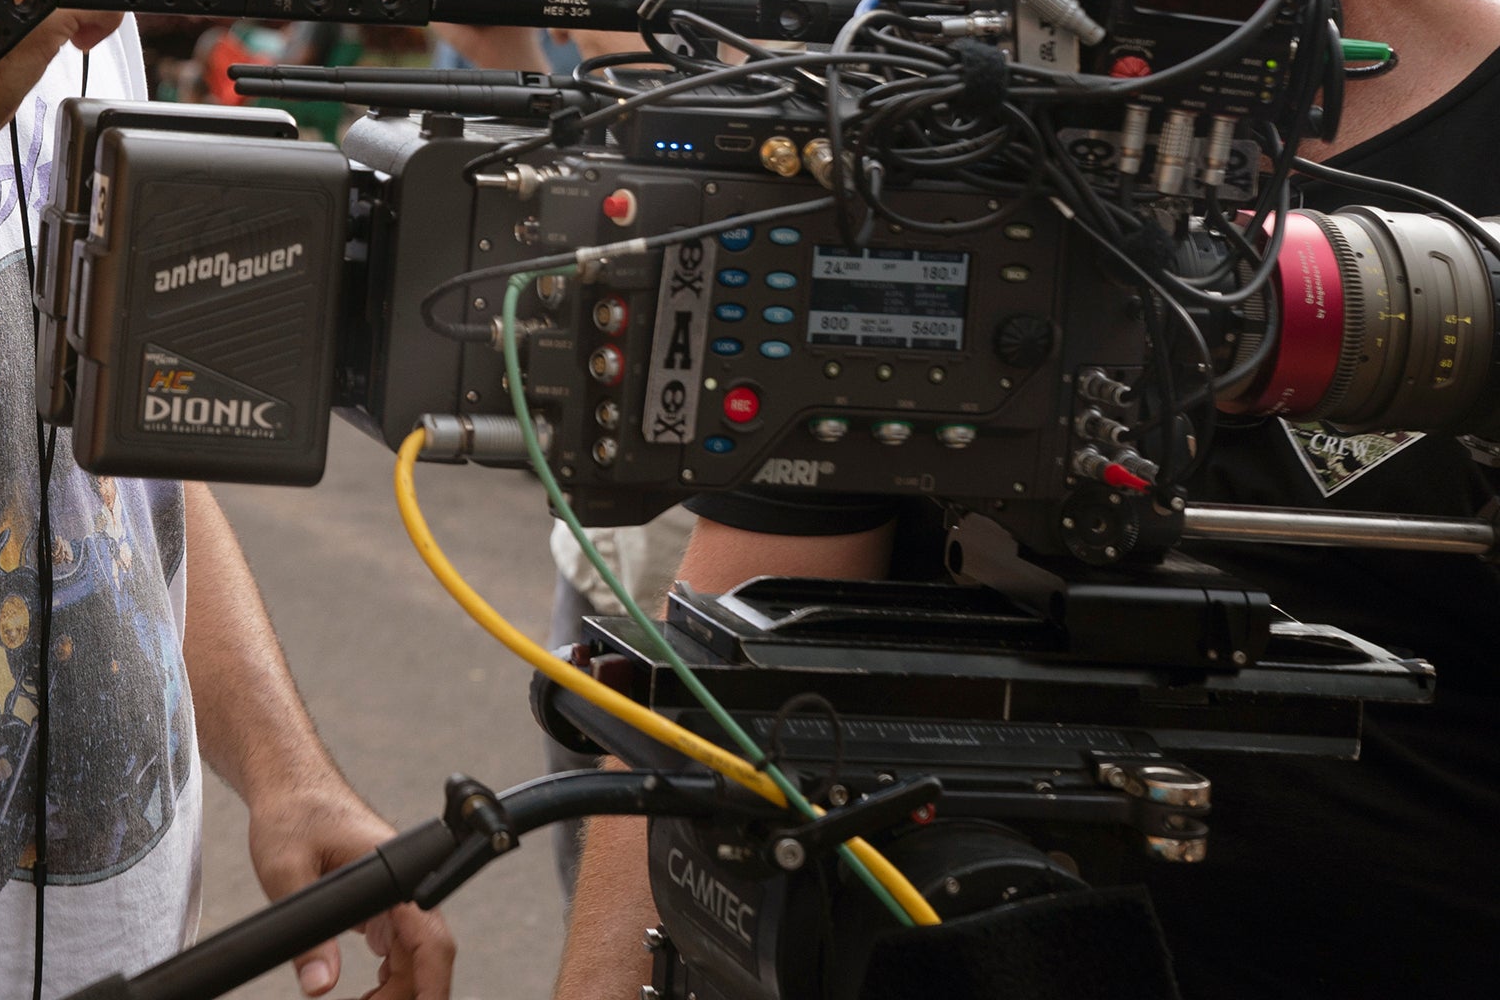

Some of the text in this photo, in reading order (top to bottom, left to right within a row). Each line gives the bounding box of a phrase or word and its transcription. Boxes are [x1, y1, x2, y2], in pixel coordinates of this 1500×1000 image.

[664, 311, 692, 370] A
[148, 368, 196, 394] HC
[144, 394, 276, 430] DIONIC
[730, 399, 752, 412] REC
[1309, 433, 1369, 458] CREW
[751, 457, 818, 486] ARRI
[668, 847, 754, 943] CAMTEC
